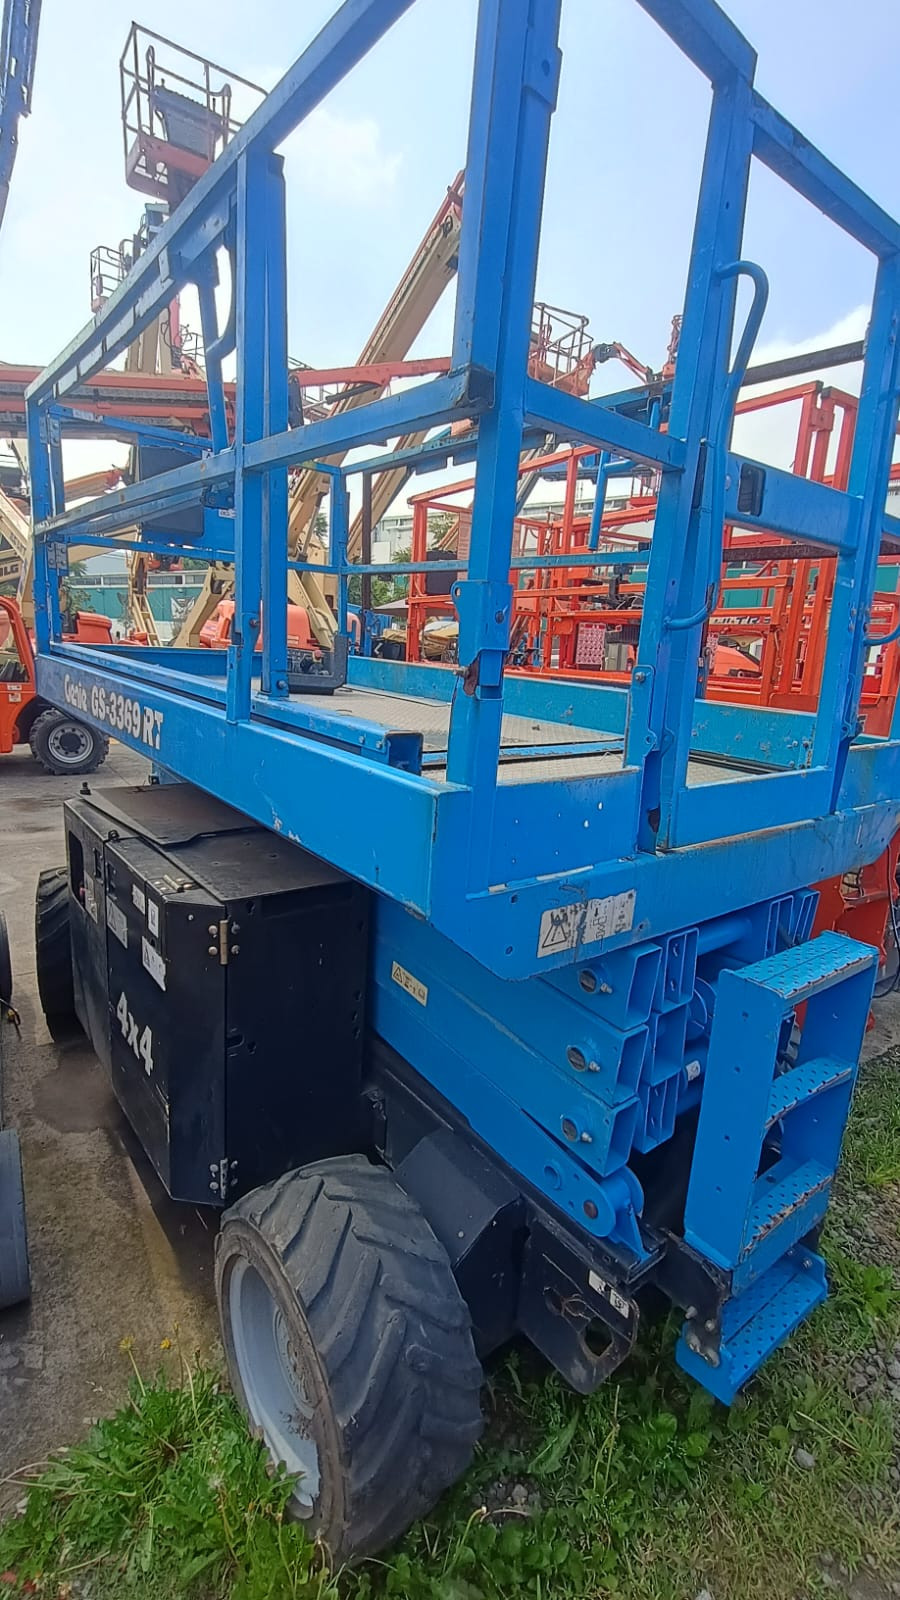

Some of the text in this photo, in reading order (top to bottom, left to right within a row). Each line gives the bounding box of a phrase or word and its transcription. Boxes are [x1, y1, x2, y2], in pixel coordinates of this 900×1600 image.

[91, 685, 141, 739] GS-3369
[143, 705, 164, 751] RT
[117, 991, 154, 1077] 4x4
